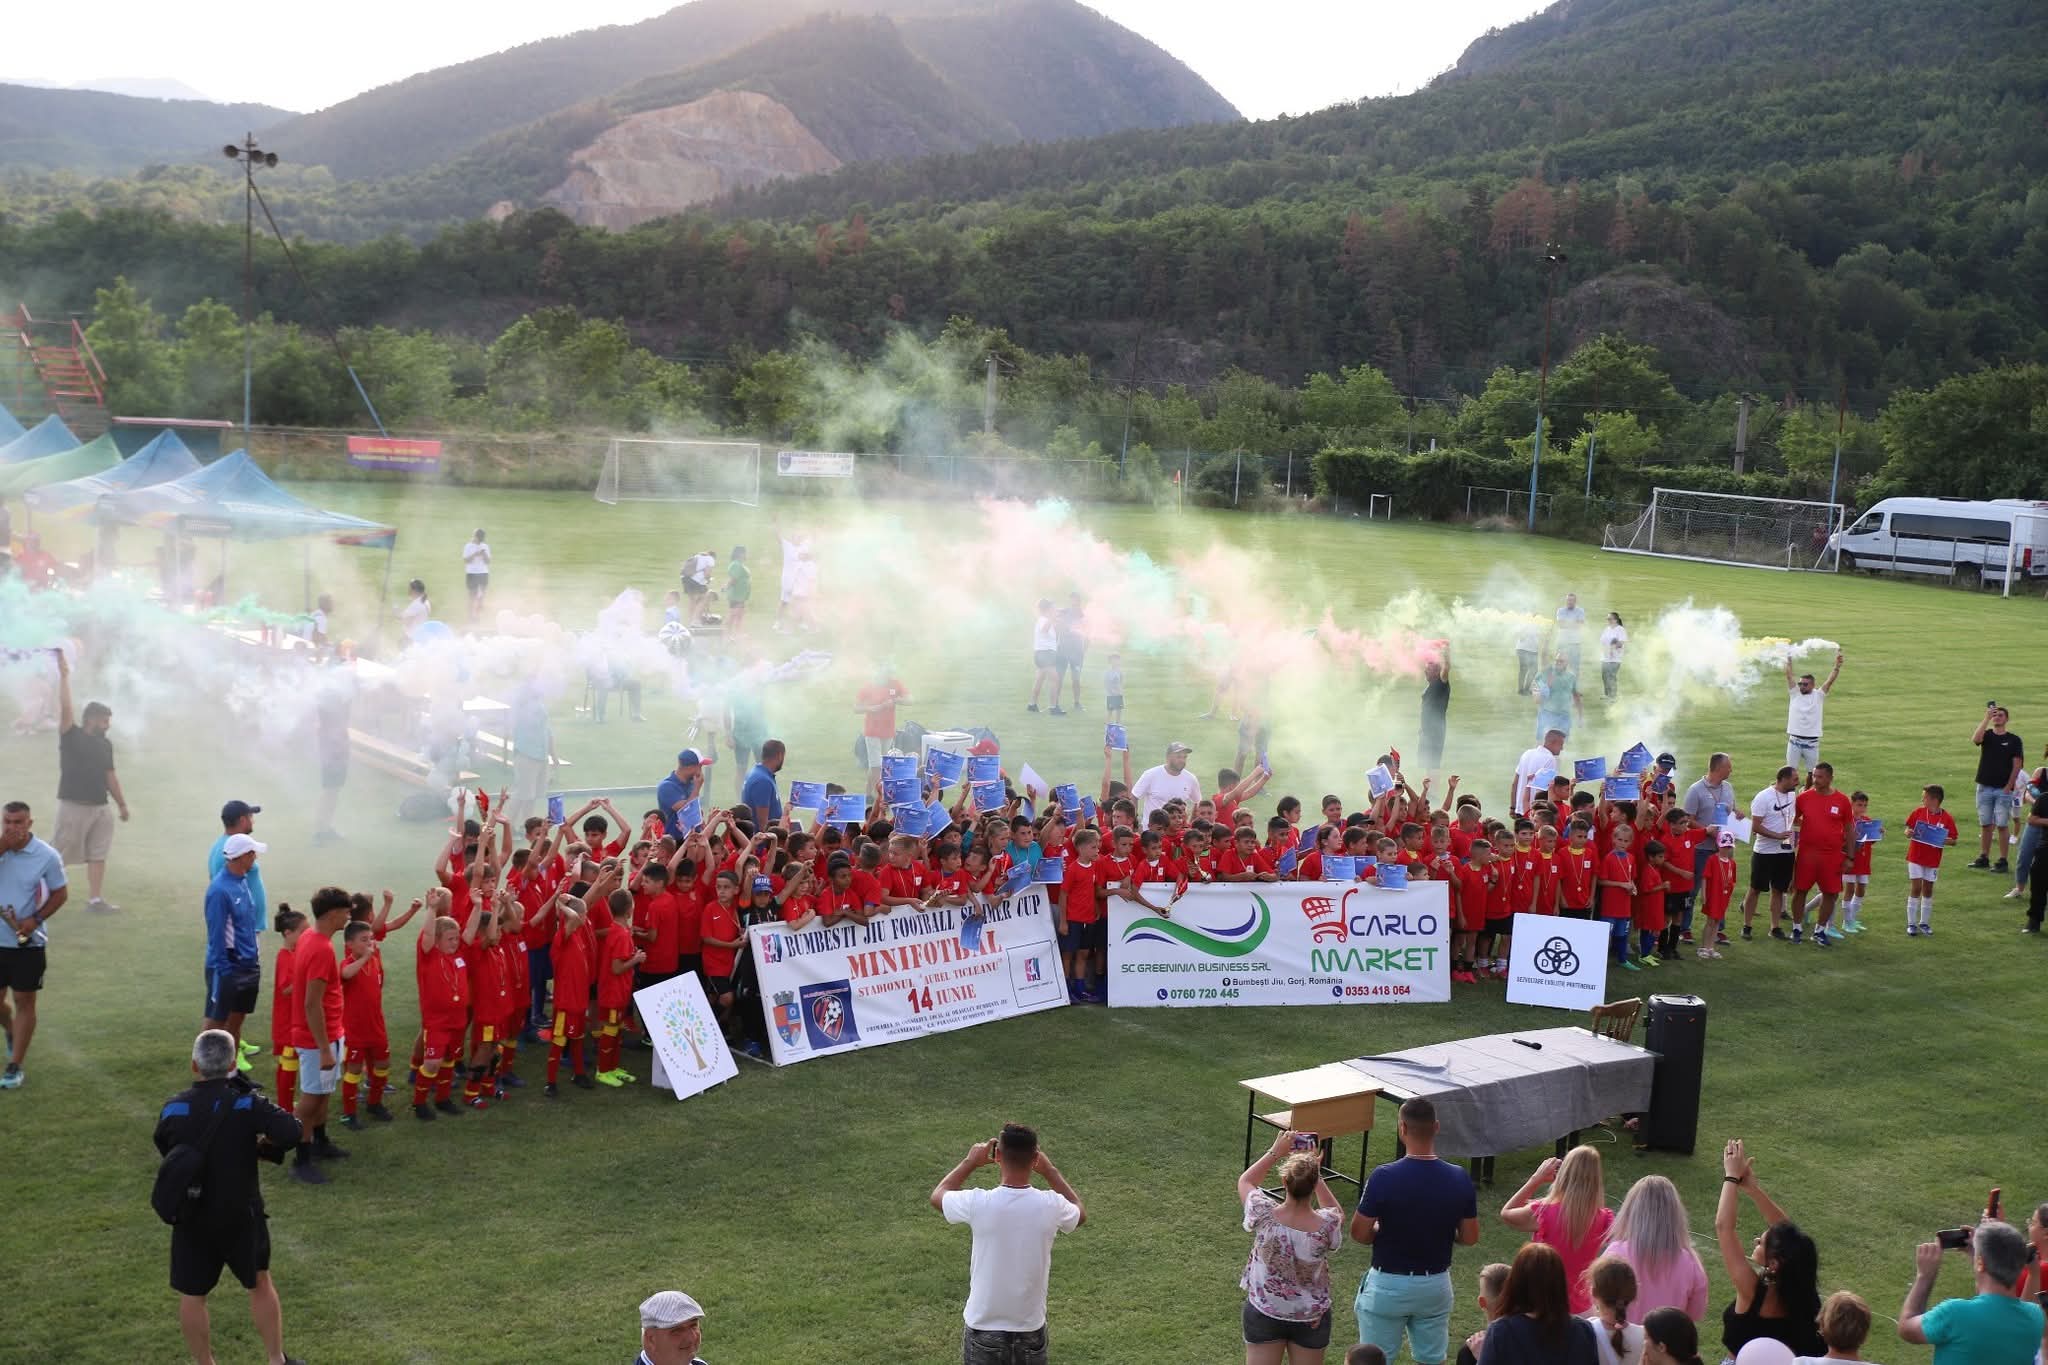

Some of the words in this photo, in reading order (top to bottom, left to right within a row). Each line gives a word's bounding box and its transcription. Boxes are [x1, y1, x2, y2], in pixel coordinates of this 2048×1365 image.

[784, 925, 857, 958] BUMBESTI
[863, 920, 887, 945] JIU
[891, 909, 955, 940] FOOTBALL
[960, 899, 1012, 925] SMER
[1016, 894, 1041, 918] CUP
[1350, 914, 1437, 936] CARLO
[1554, 941, 1561, 950] E
[1121, 963, 1136, 973] SC
[1137, 962, 1197, 973] GREENINIA
[1199, 962, 1250, 972] BUSINESS
[1251, 962, 1272, 972] SRL
[1311, 947, 1439, 972] MARKET
[1541, 959, 1549, 967] D
[1564, 961, 1572, 969] P
[857, 977, 915, 998] STADIONUL
[1170, 988, 1196, 1000] 0760
[1199, 988, 1217, 999] 720
[1220, 988, 1239, 998] 445
[1345, 986, 1370, 996] 0353
[1371, 986, 1390, 996] 418
[1392, 985, 1411, 995] 064
[907, 985, 934, 1014] 14
[936, 983, 977, 1005] IUNIE
